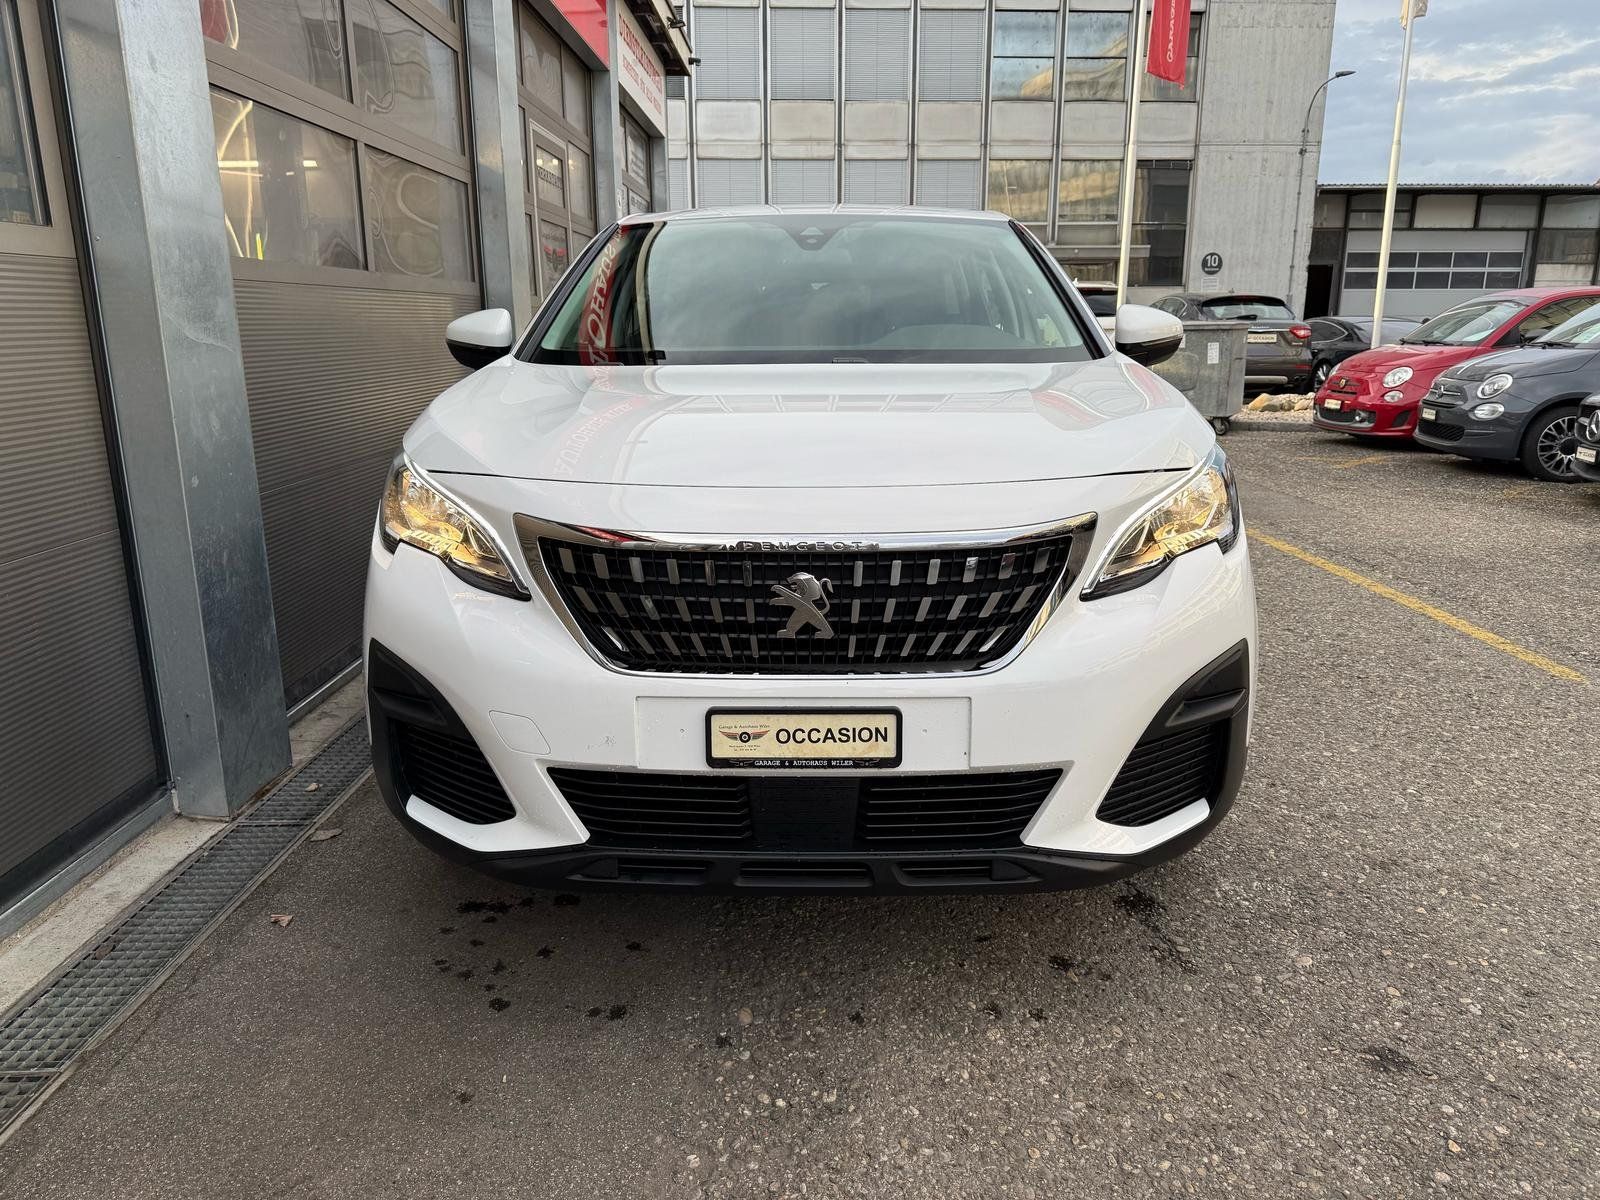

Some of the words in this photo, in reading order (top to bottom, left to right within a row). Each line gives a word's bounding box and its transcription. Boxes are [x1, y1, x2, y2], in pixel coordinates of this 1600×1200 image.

[1205, 254, 1219, 267] 10
[743, 541, 864, 550] PEUGEOT
[775, 726, 888, 744] OCCASION
